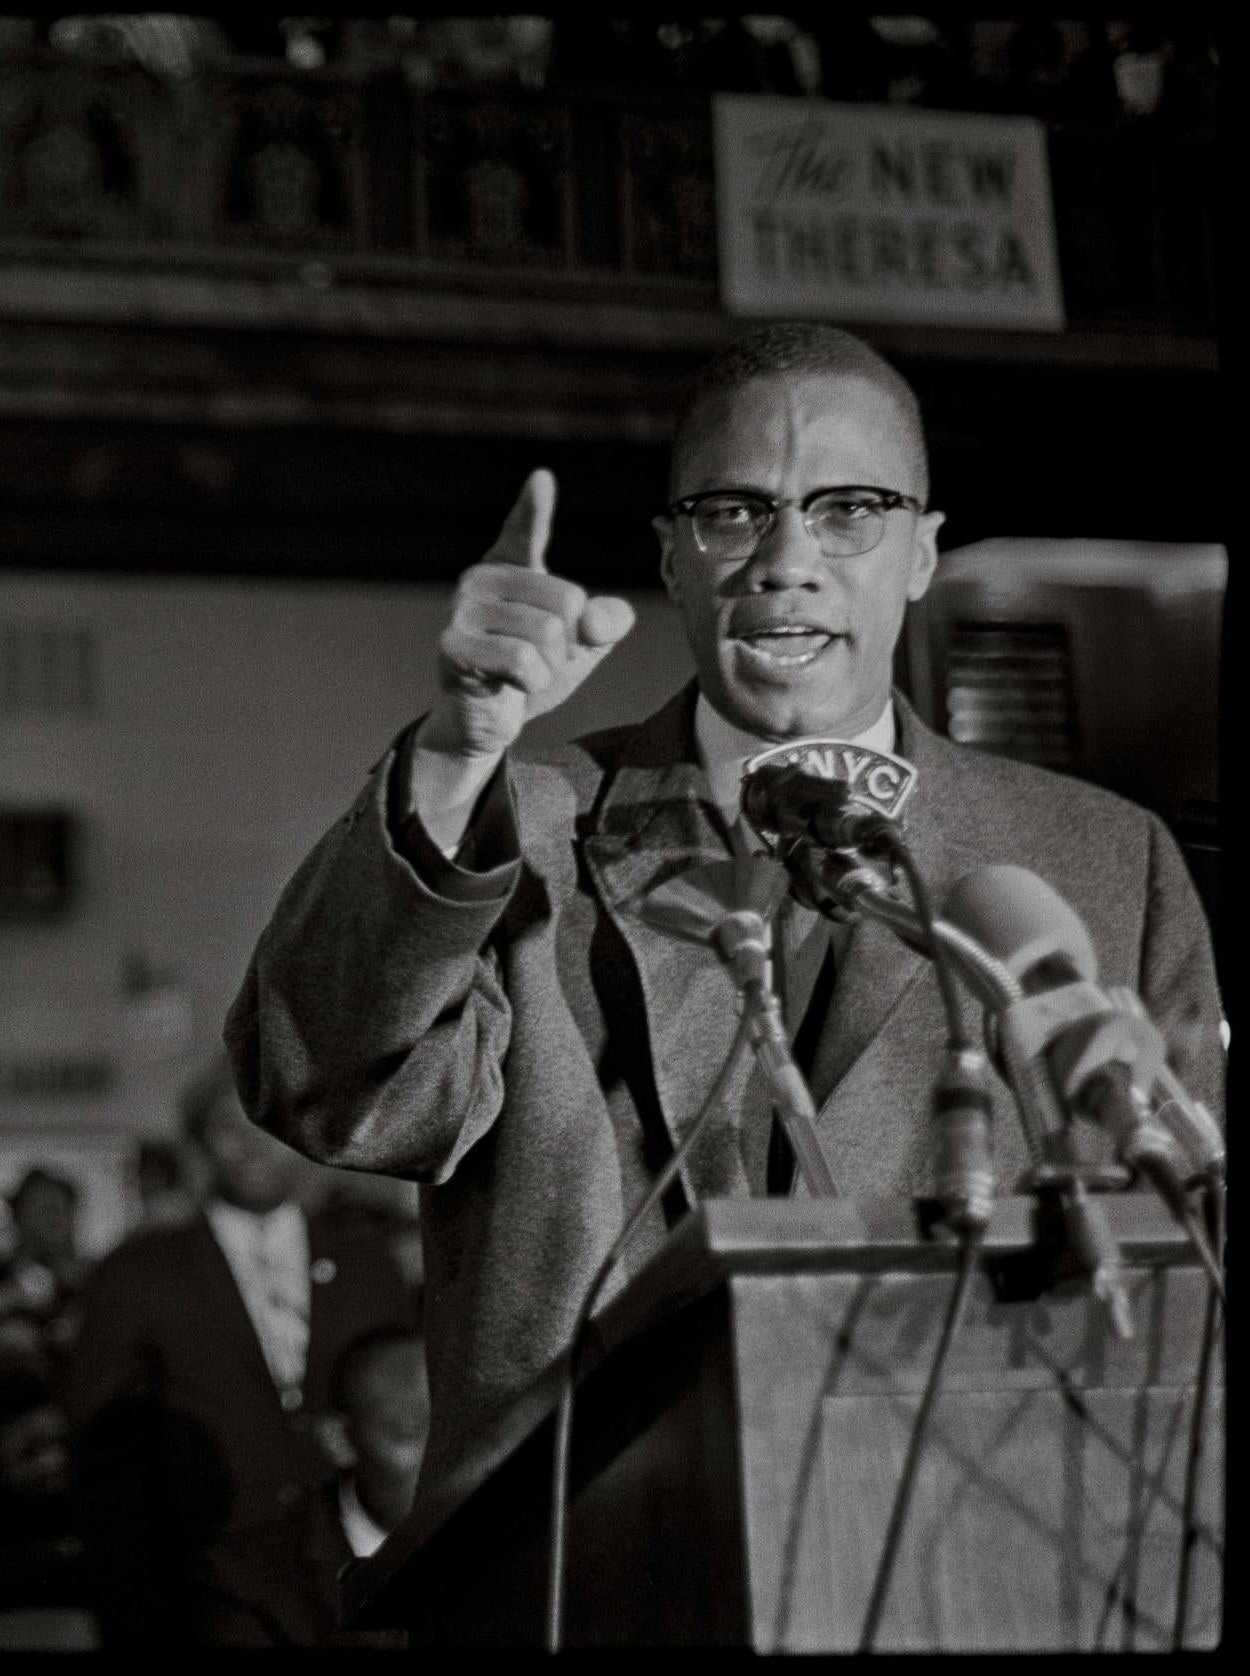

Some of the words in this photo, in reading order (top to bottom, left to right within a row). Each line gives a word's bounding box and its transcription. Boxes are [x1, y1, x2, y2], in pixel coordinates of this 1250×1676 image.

[744, 116, 854, 204] The
[868, 134, 1018, 204] NEW
[749, 206, 1036, 294] THERESA
[784, 749, 900, 800] NYC
